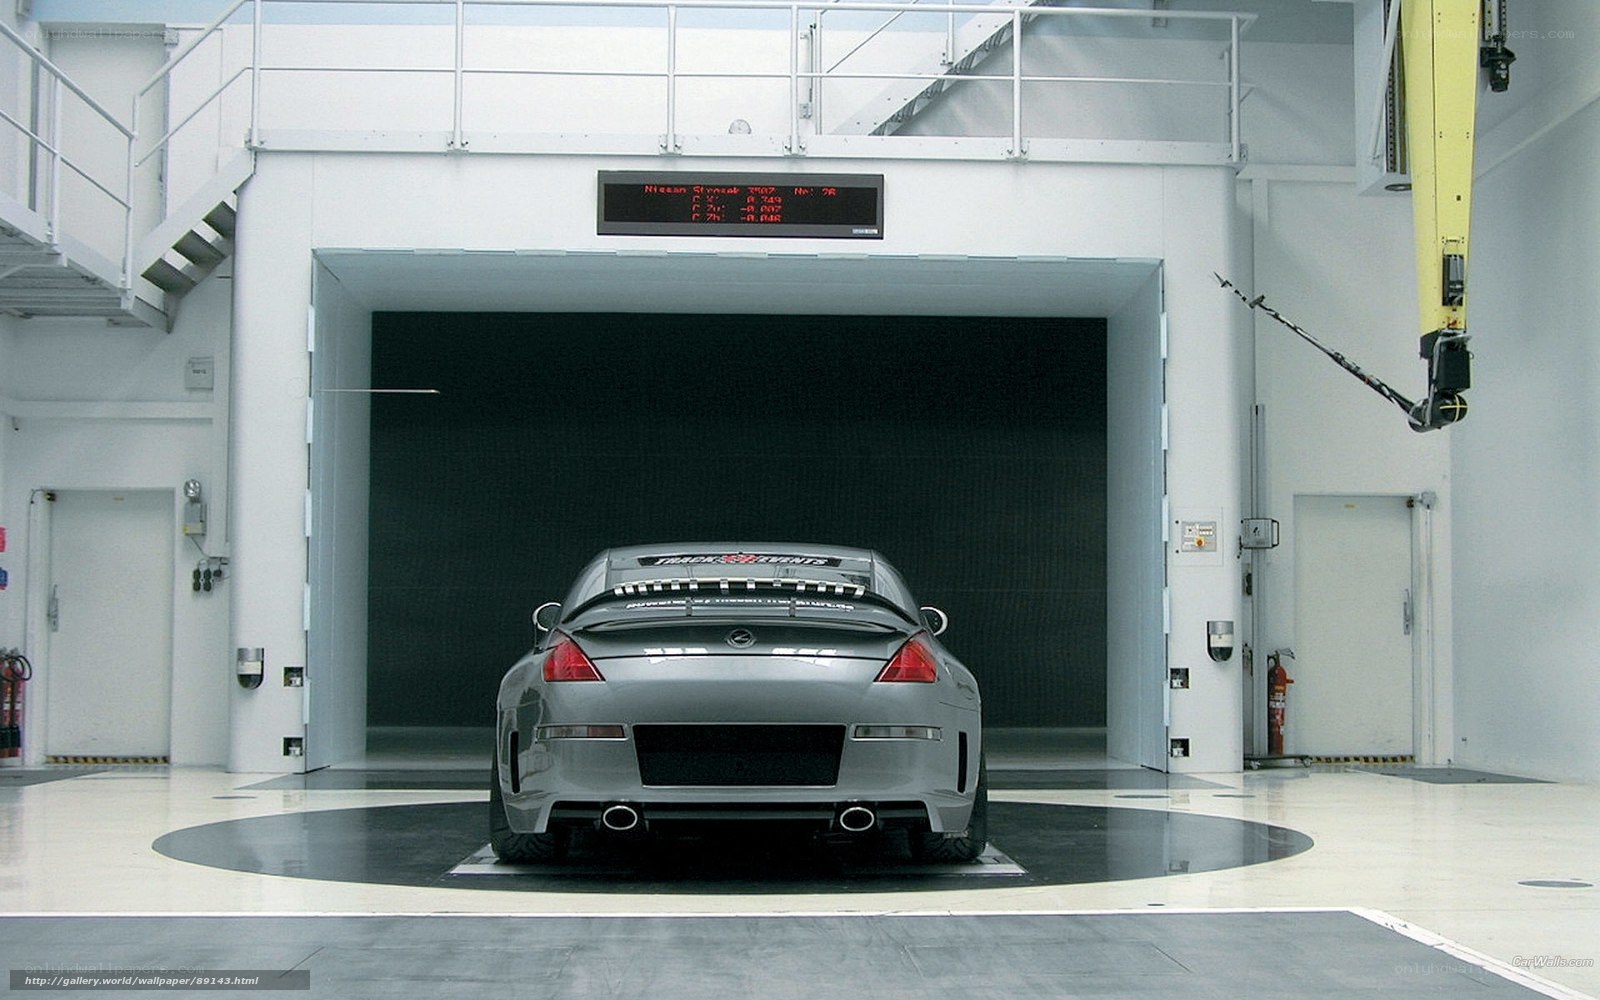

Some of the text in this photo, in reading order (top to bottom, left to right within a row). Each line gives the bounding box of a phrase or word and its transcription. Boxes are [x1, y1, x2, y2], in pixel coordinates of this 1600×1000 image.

[644, 185, 687, 194] Nissan
[654, 556, 829, 566] TRACK EVENTS
